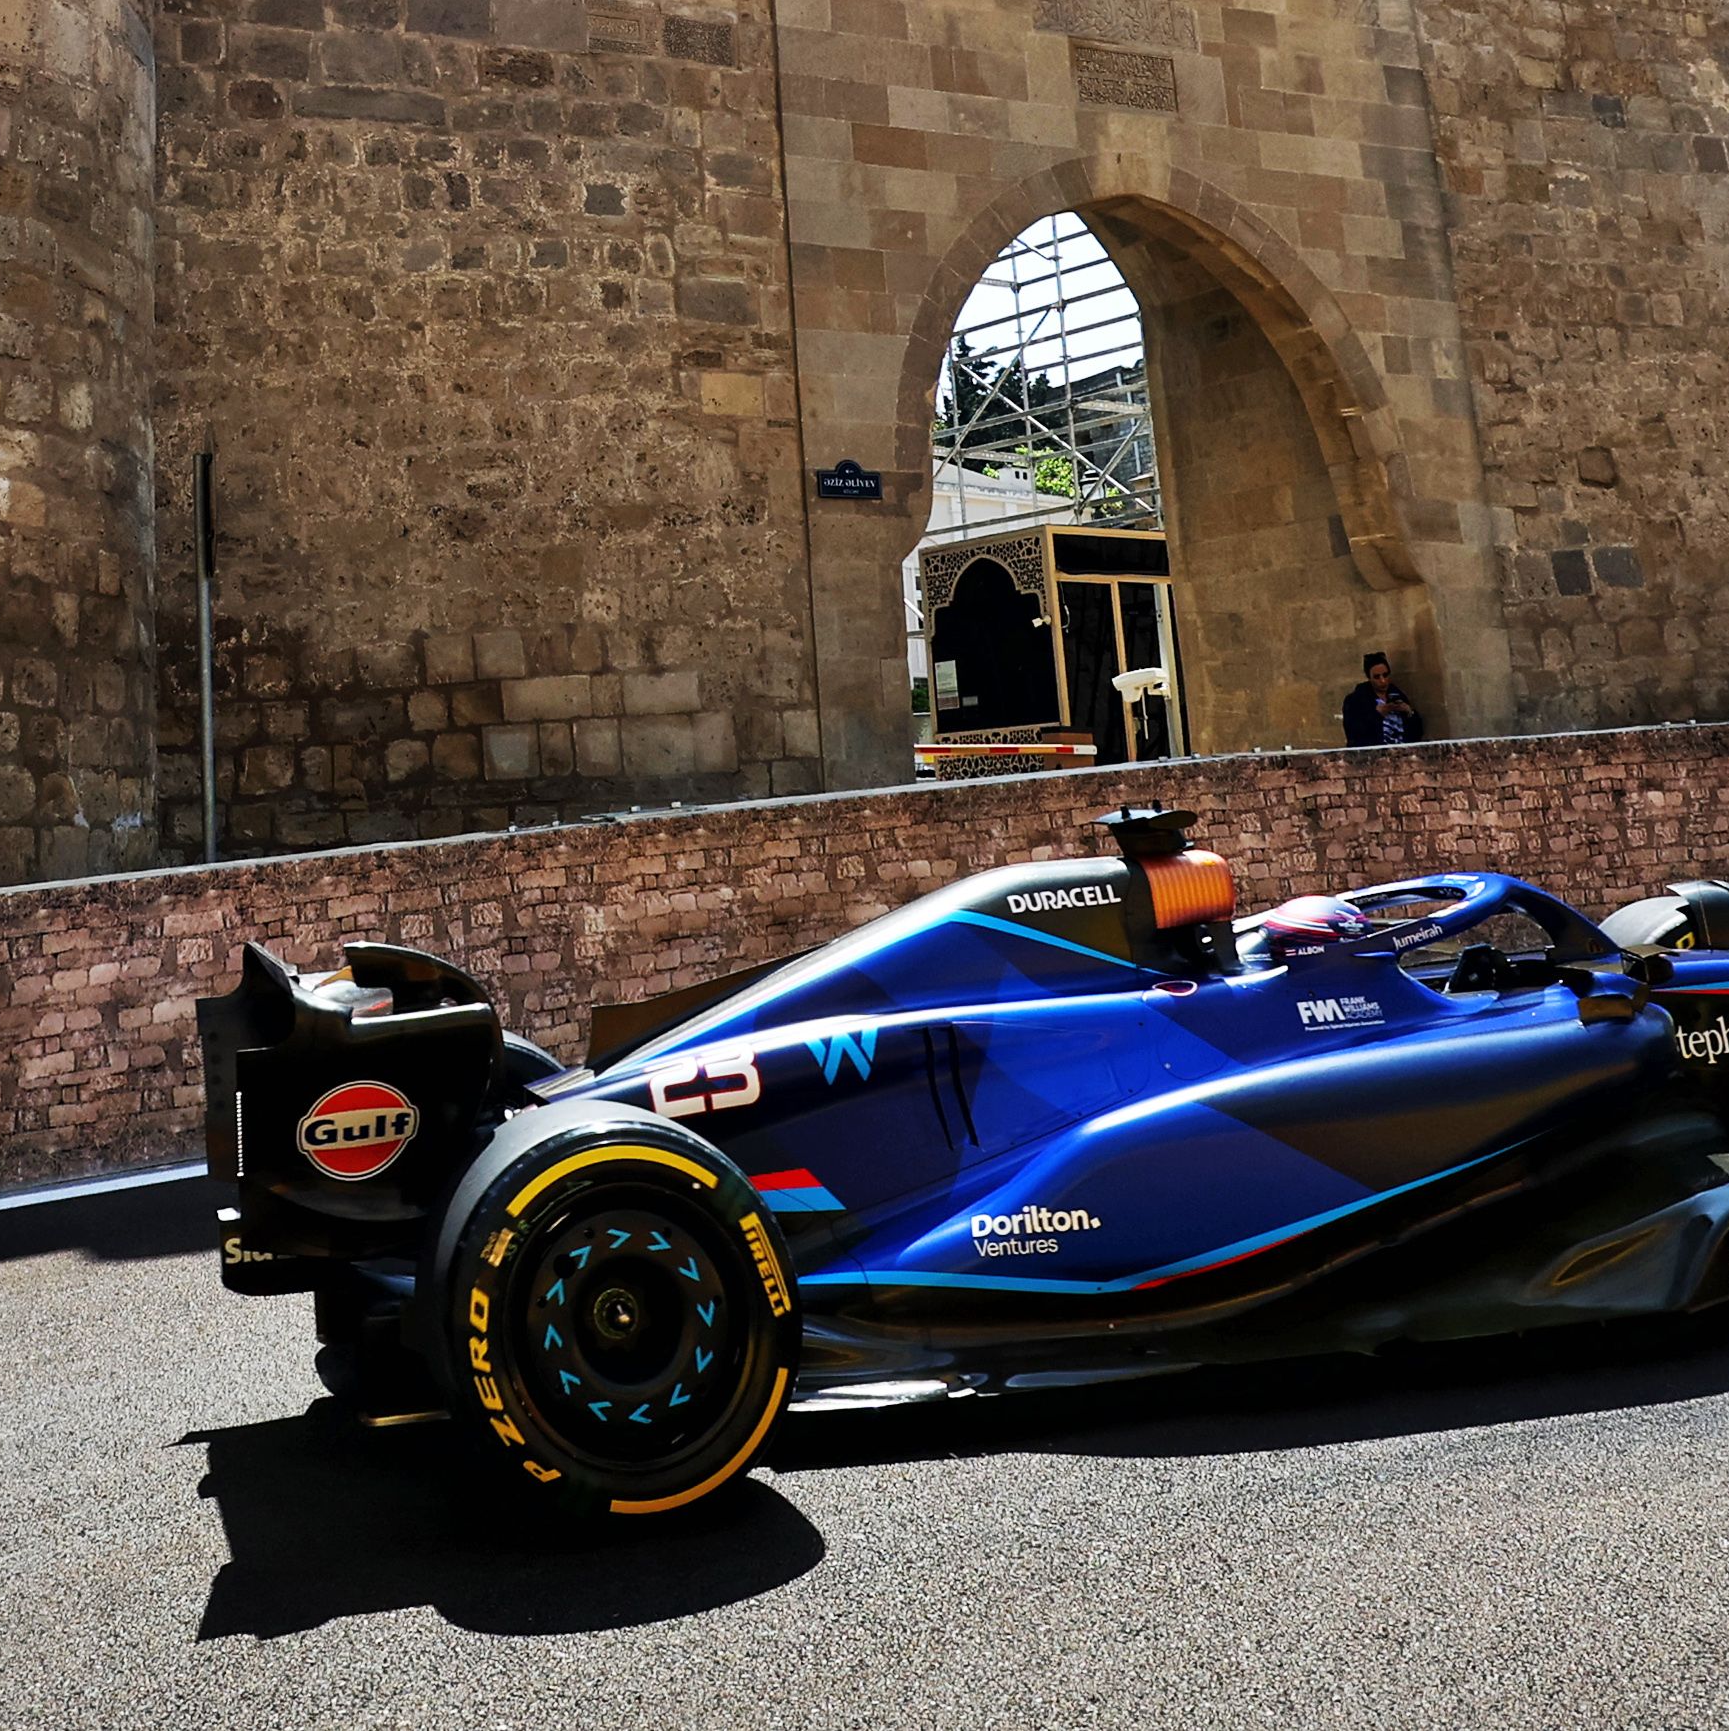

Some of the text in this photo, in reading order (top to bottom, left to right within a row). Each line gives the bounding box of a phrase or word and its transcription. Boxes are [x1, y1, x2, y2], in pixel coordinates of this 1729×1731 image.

[1006, 883, 1122, 914] DURACELL
[1297, 946, 1325, 956] ALBON
[1392, 923, 1443, 951] Jumeirah
[646, 1042, 762, 1119] 23
[304, 1112, 412, 1146] Gulf
[973, 1237, 1059, 1257] Ventures
[738, 1211, 792, 1317] PIRELLI
[469, 1286, 526, 1447] ZERO
[523, 1460, 562, 1483] P
